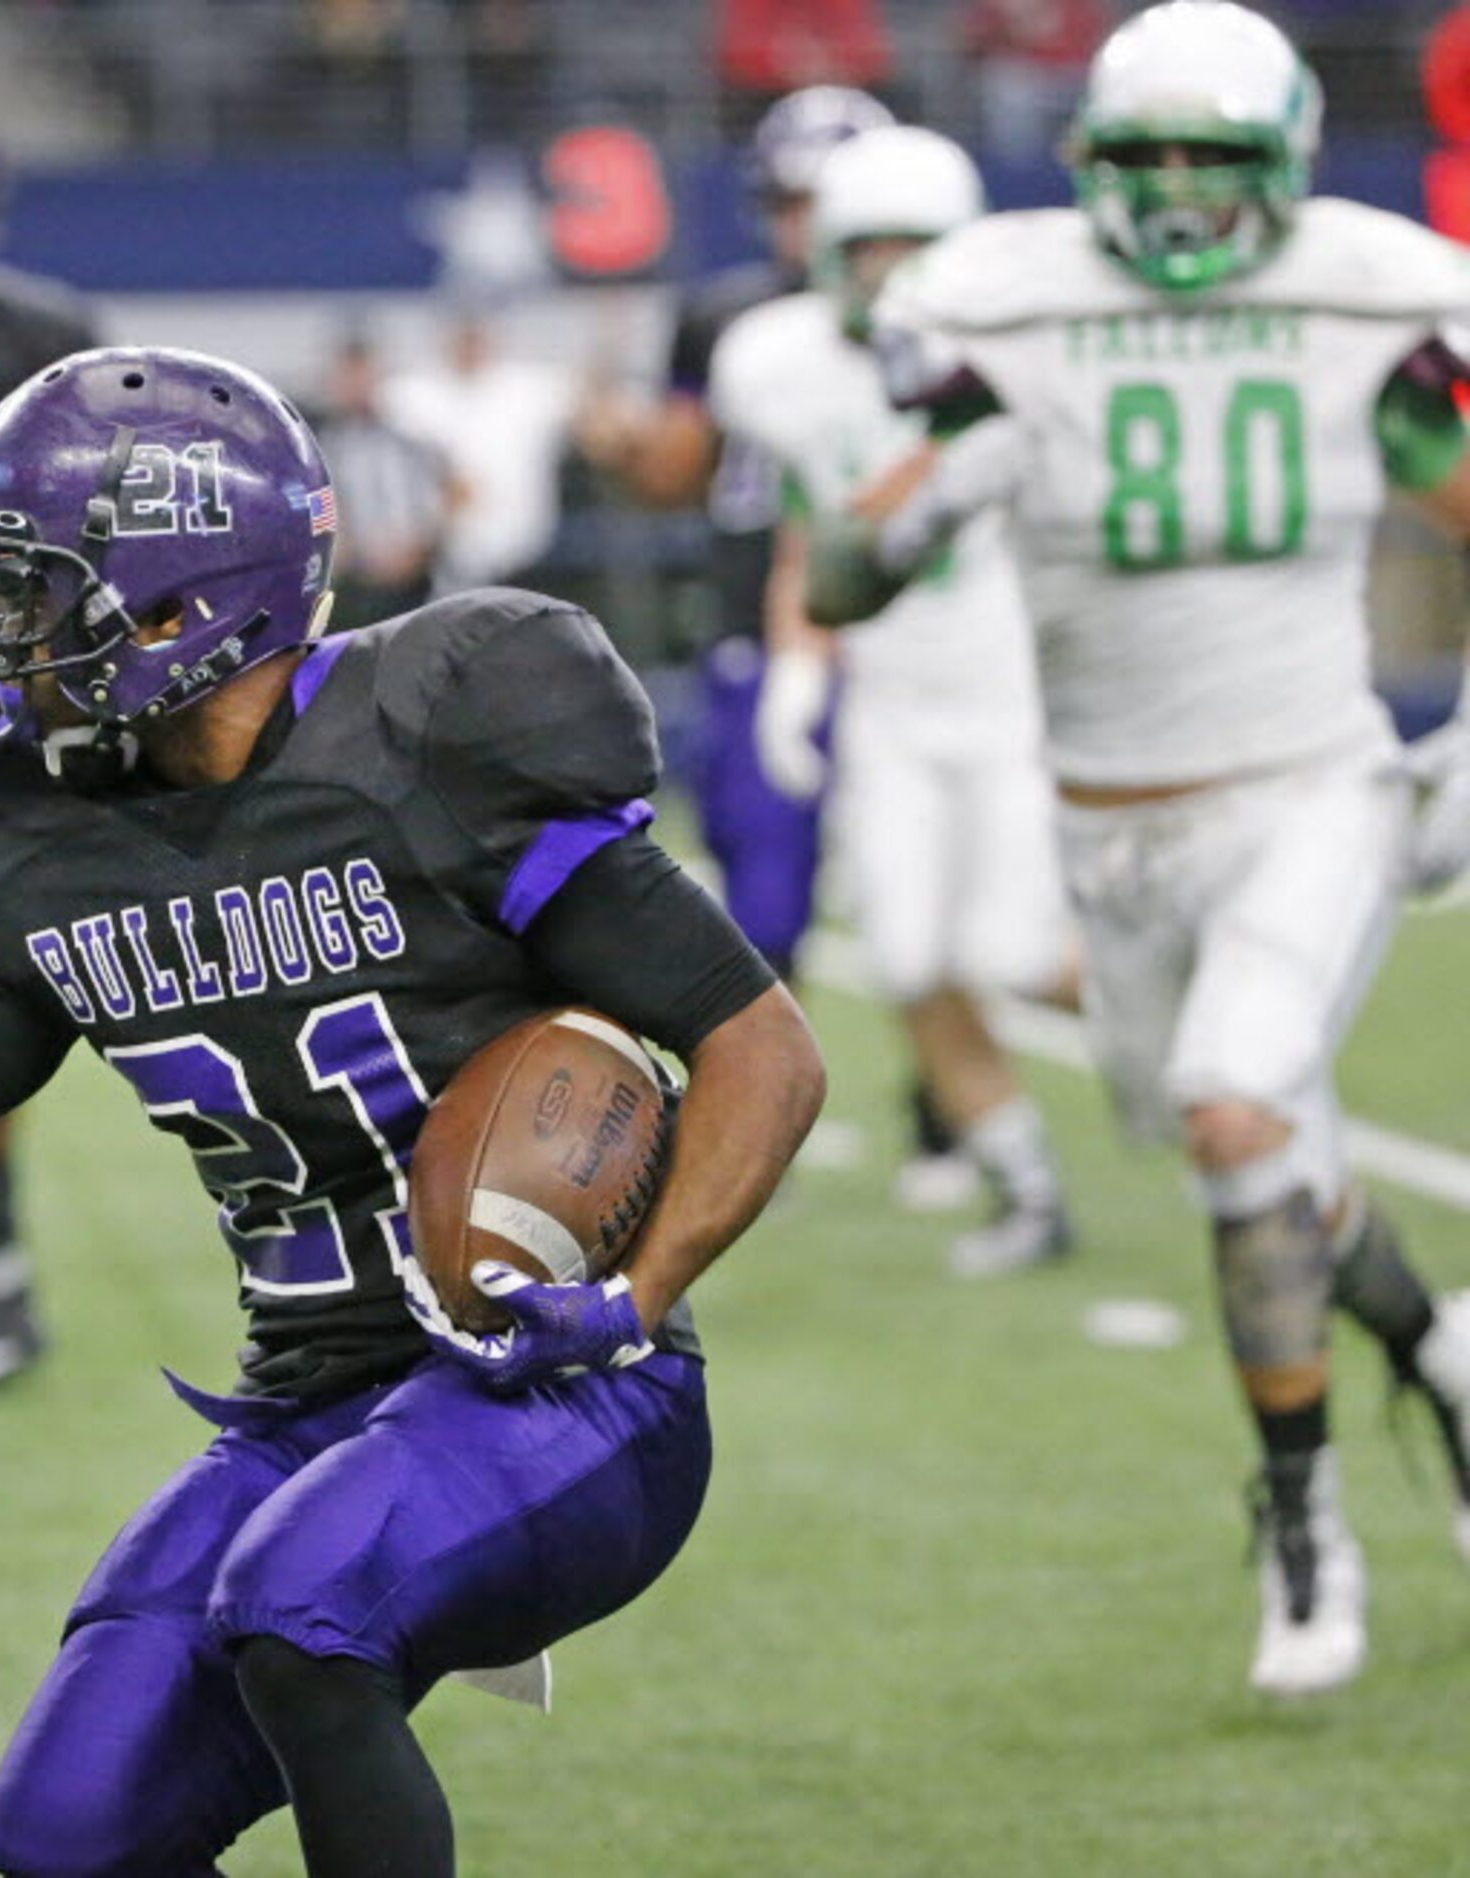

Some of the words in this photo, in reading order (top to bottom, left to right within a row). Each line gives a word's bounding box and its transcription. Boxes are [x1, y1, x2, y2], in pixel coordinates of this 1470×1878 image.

[110, 441, 230, 537] 21
[1103, 379, 1305, 573] 80
[26, 858, 404, 1023] BULLDOGS
[102, 990, 432, 1295] 21
